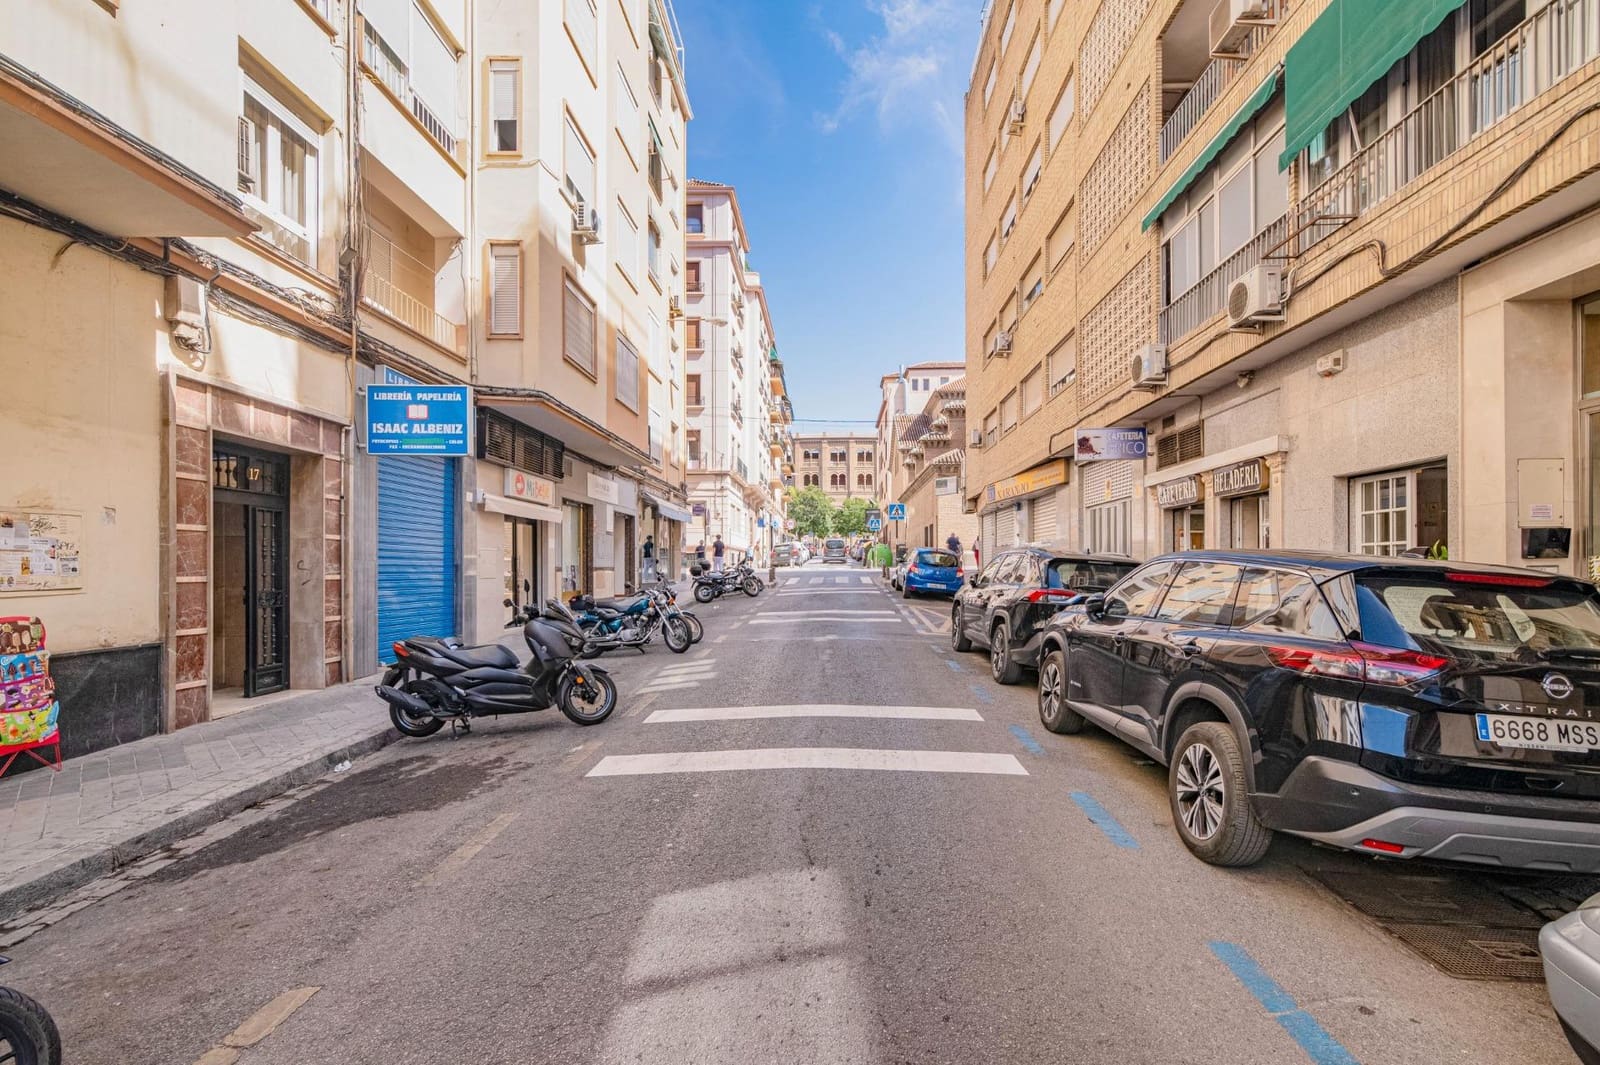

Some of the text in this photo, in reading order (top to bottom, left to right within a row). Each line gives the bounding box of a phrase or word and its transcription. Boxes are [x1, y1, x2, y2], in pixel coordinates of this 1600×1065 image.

[373, 391, 462, 401] LIBRERÍA PAPELERÍA
[372, 423, 463, 434] ISAAC ALBENIZ
[249, 467, 260, 480] 17
[1214, 463, 1260, 493] HELADERIA
[1158, 479, 1197, 505] CAFETERIA
[1542, 683, 1574, 691] NISSAN
[1493, 719, 1598, 745] 6668 MSS
